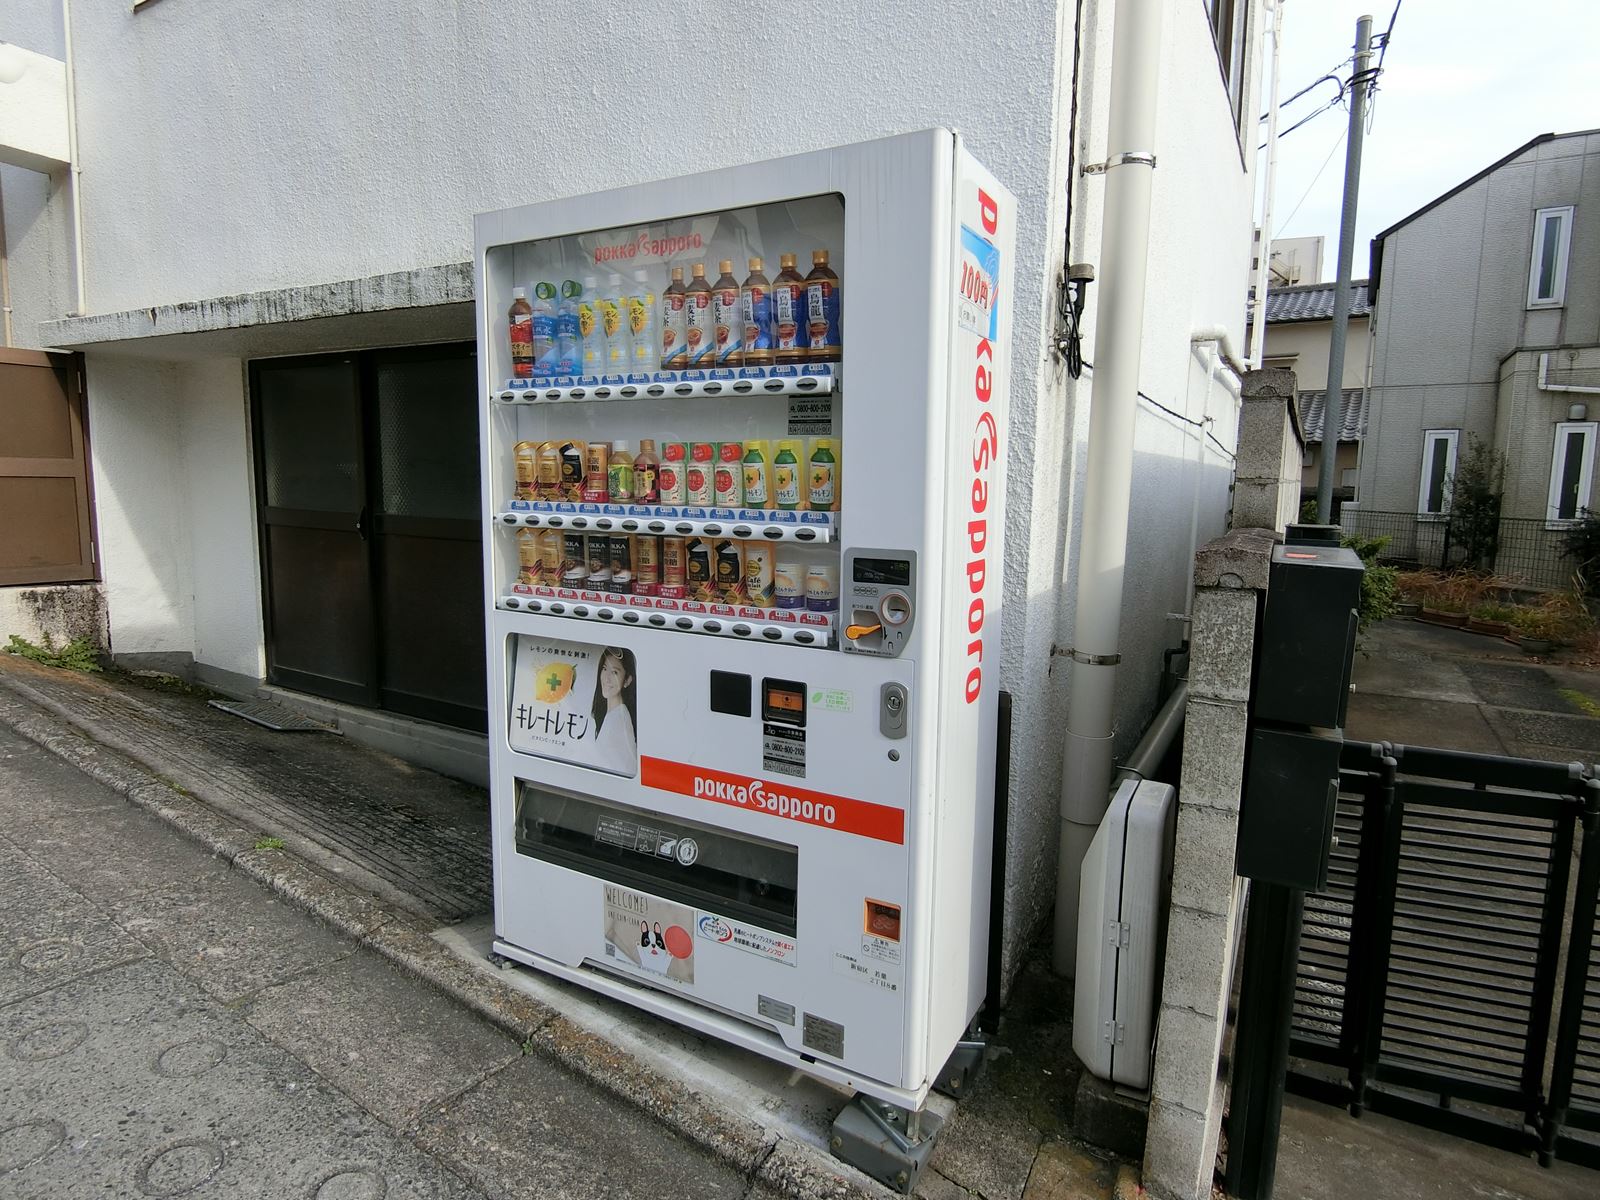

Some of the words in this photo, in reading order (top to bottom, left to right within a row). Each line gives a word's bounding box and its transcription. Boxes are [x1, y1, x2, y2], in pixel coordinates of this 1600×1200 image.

[965, 437, 988, 704] sapporo
[516, 704, 588, 740] キレートレモン
[755, 790, 836, 824] sapporo
[605, 887, 649, 915] WELCOME!
